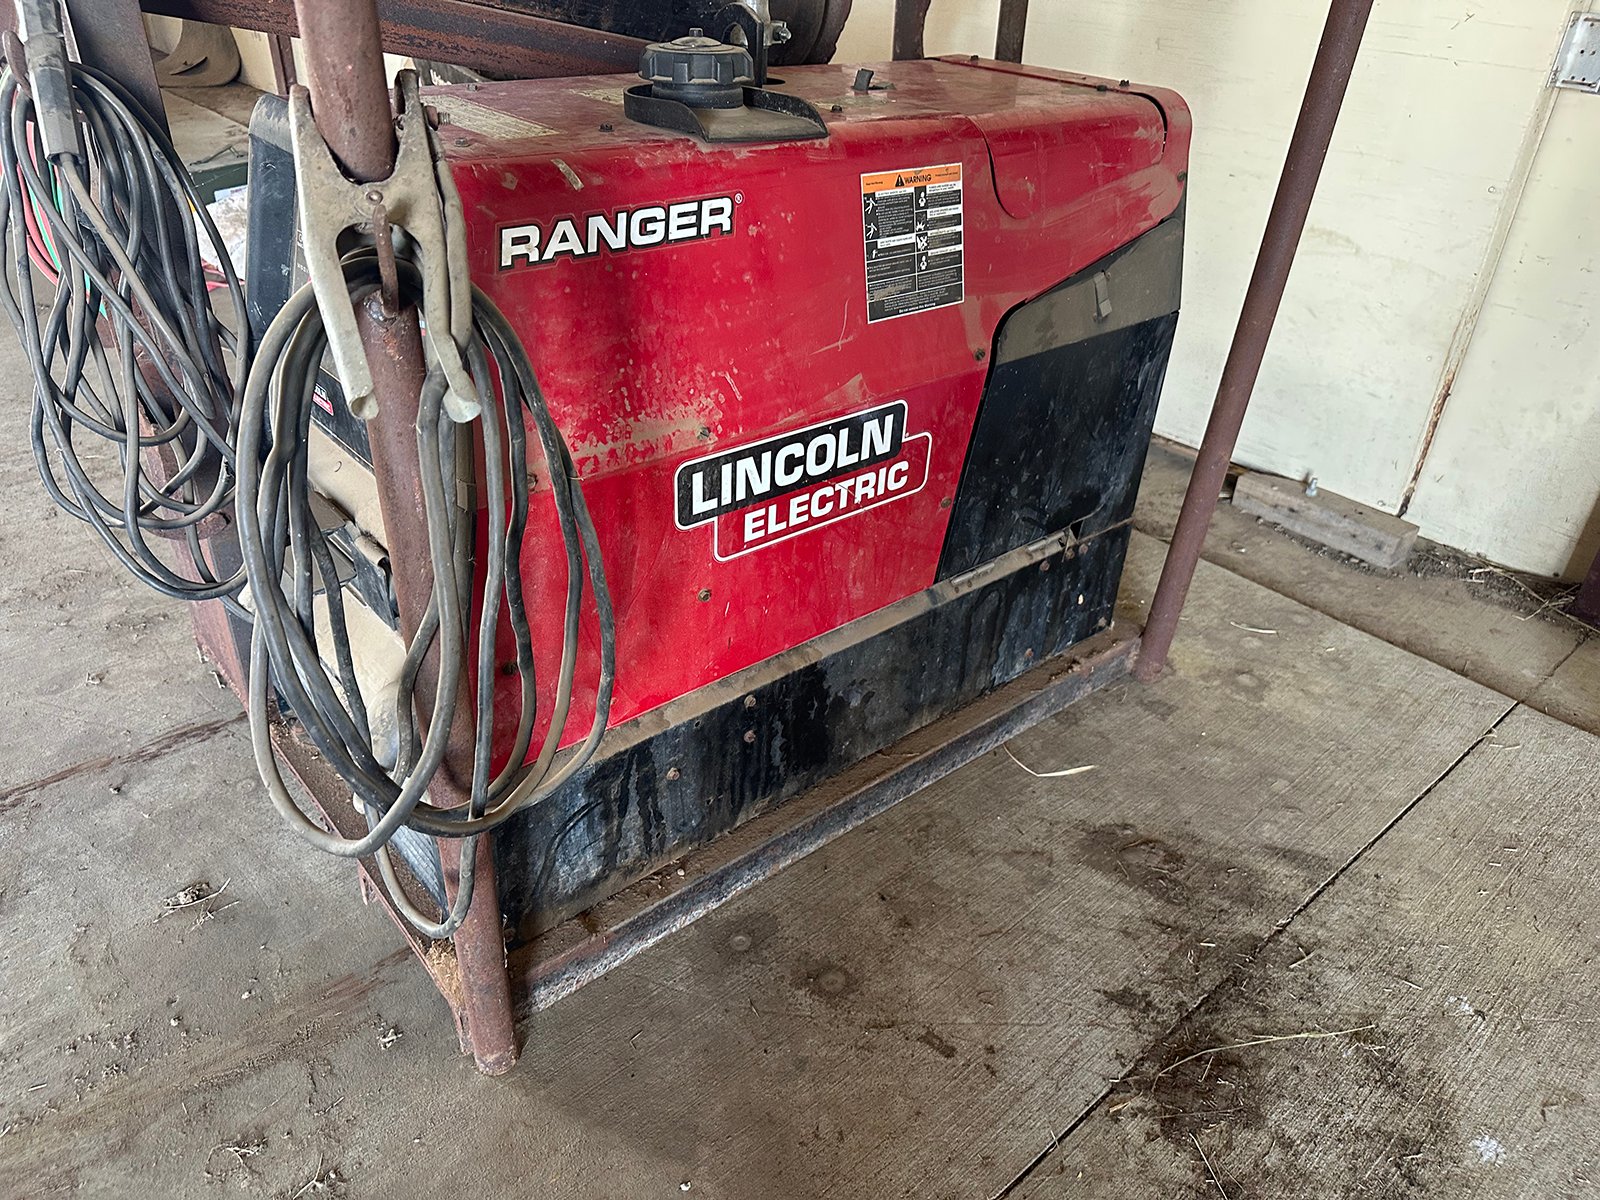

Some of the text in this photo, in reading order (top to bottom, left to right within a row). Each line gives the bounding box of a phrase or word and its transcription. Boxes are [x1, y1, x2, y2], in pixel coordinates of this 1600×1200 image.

[904, 174, 932, 184] WARNING
[500, 197, 733, 267] RANGER
[691, 413, 894, 516] LINCOLN
[743, 460, 909, 543] ELECTRIC
